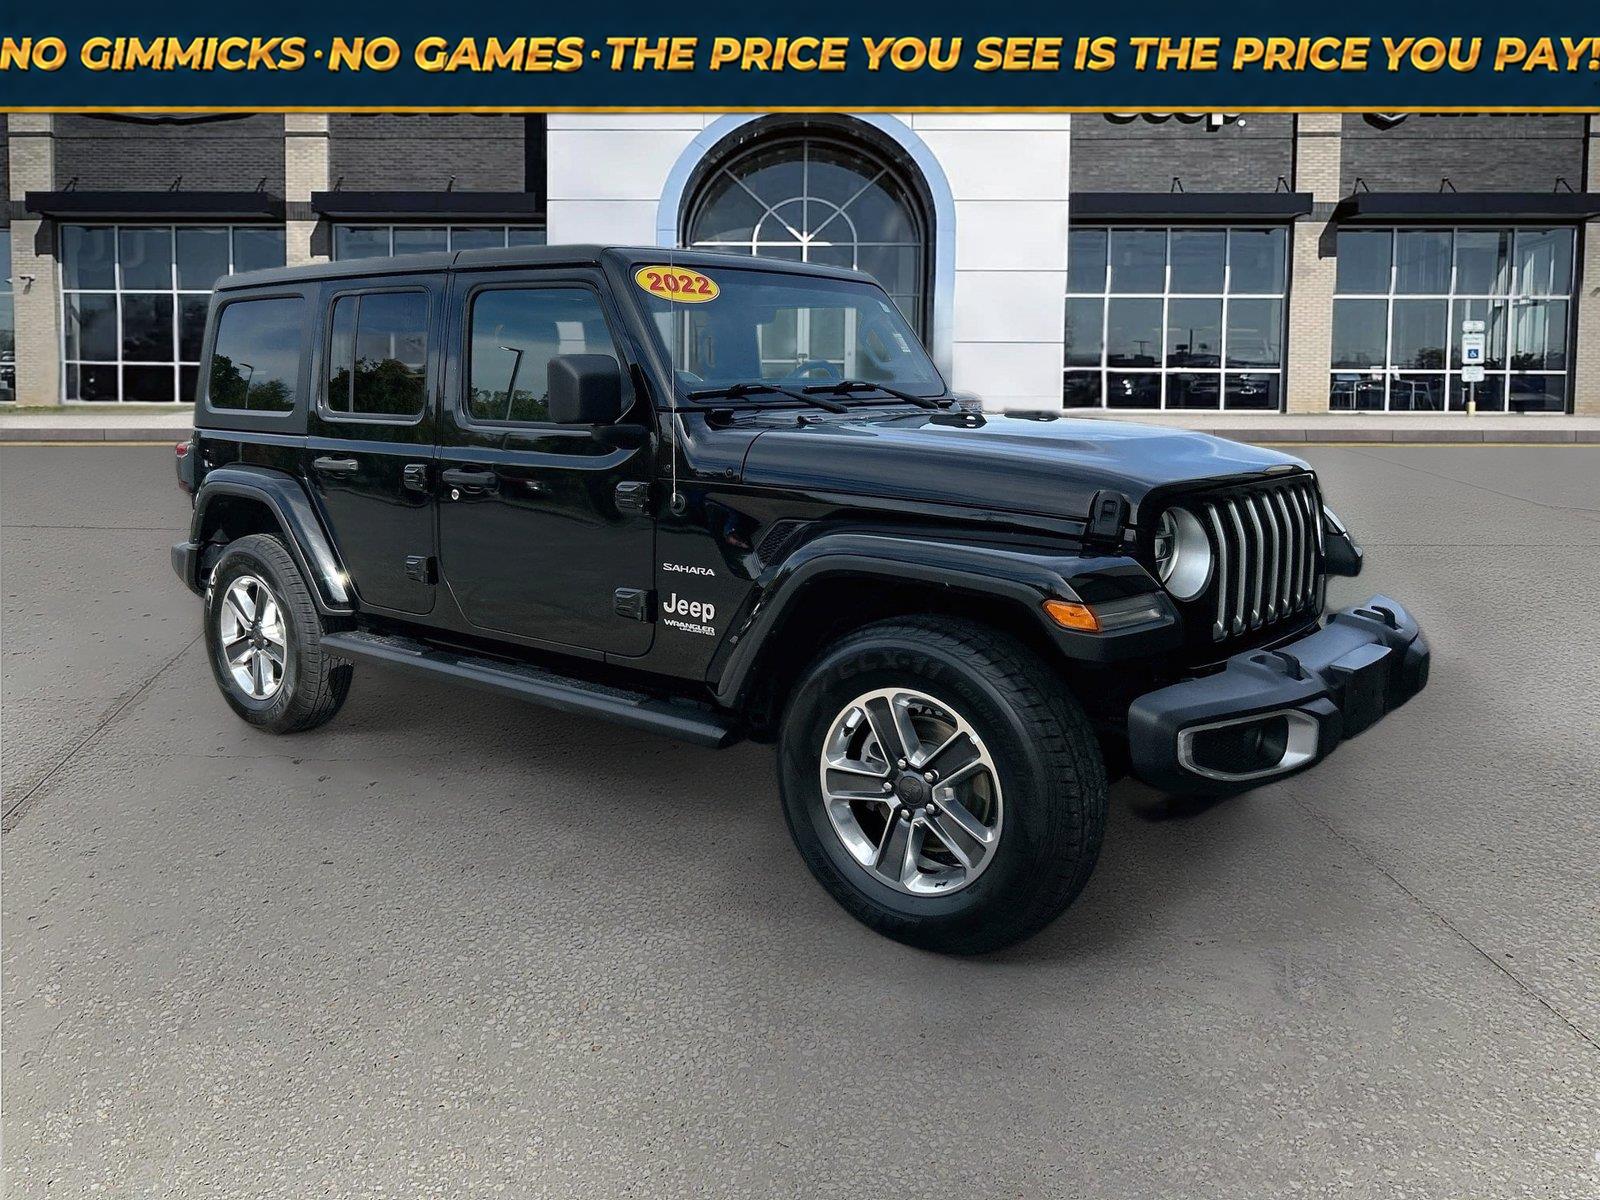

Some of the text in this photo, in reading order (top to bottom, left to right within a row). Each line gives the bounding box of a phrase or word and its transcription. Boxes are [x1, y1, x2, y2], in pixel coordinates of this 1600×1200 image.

[646, 272, 713, 295] 2022
[662, 562, 715, 576] SAHARA
[663, 593, 715, 623] Jeep
[663, 618, 715, 633] WRANGLER
